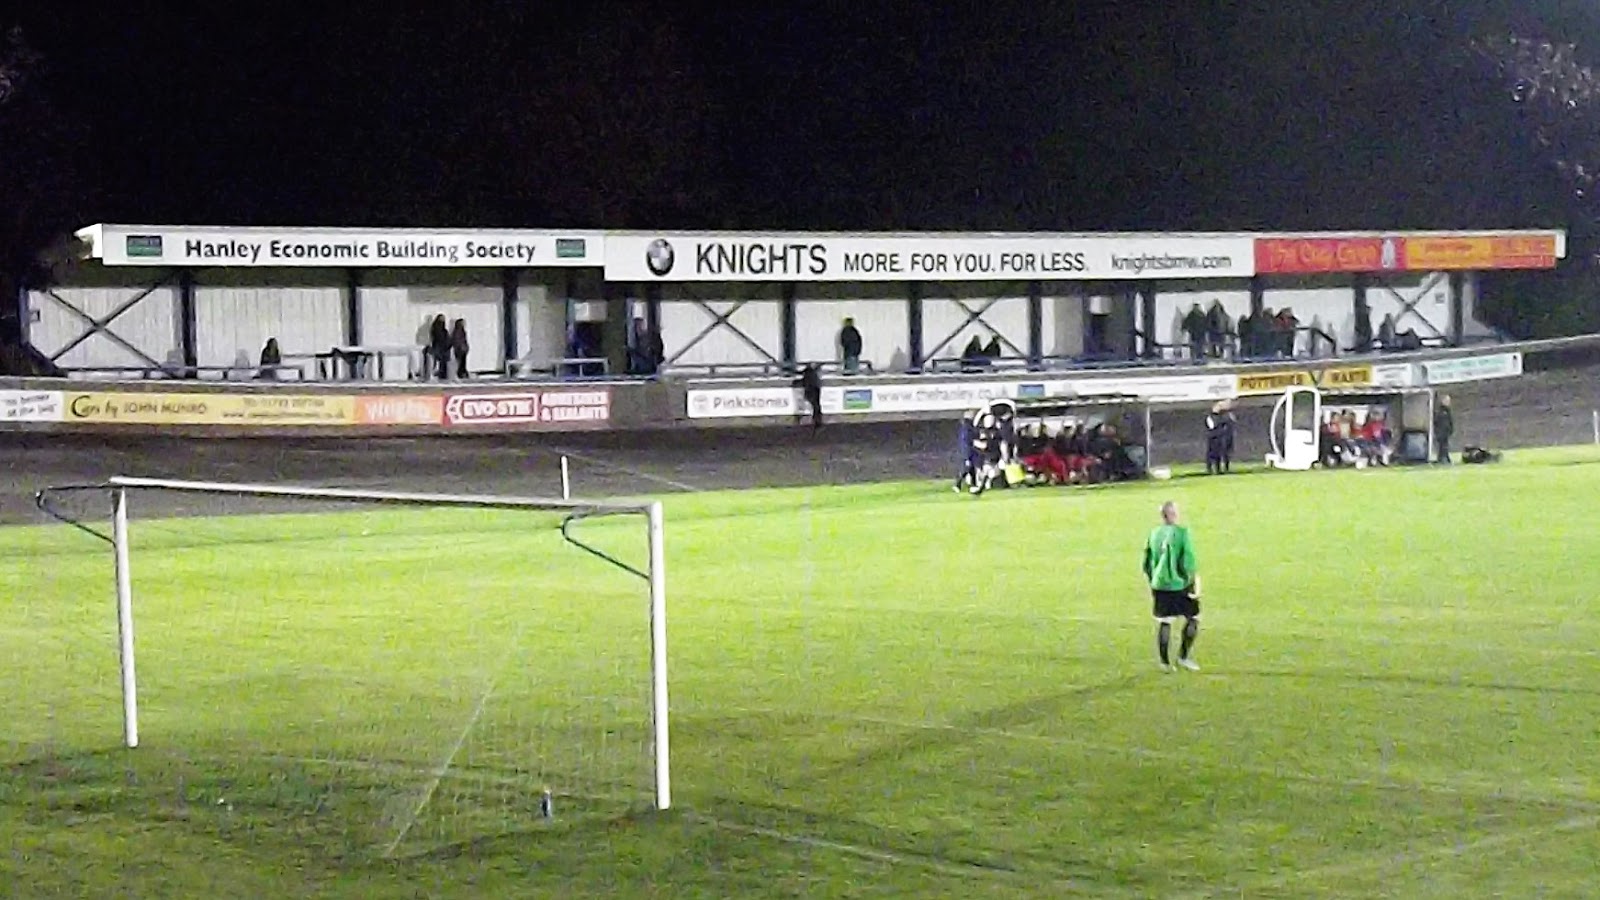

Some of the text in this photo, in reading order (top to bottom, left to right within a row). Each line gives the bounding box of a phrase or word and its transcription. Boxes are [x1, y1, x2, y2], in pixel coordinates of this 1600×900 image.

[185, 239, 536, 264] Hanley Economic Building Society
[695, 243, 828, 275] KNIGHTS
[843, 252, 1090, 273] MORE. FOR YOU. FOR LESS.
[1111, 252, 1233, 275] knightsbmw.com
[123, 402, 158, 415] JOHN
